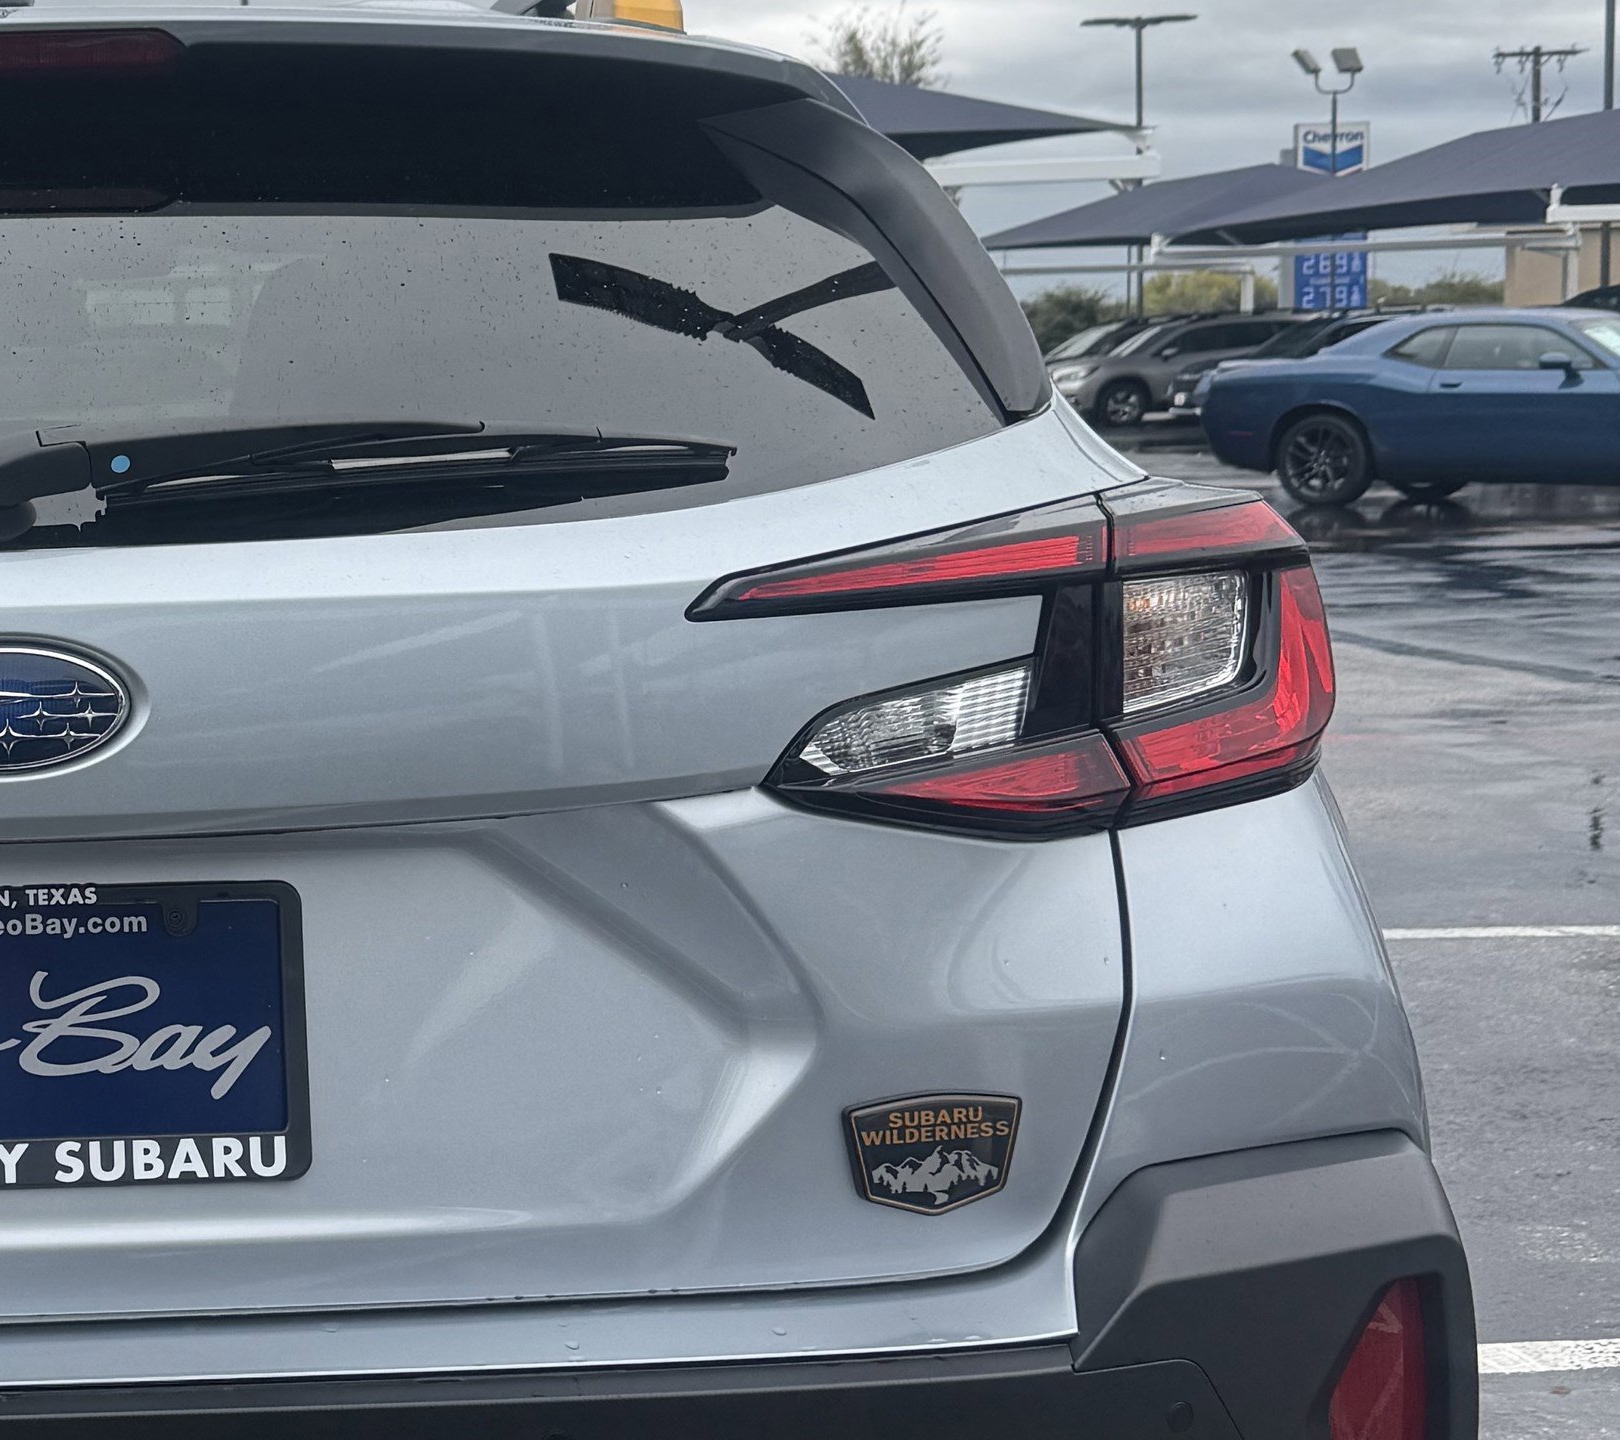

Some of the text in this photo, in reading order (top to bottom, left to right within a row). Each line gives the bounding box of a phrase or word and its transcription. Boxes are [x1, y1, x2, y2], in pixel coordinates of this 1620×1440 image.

[1303, 130, 1364, 144] Cheron
[25, 886, 98, 906] TEXAS
[18, 971, 272, 1100] Bay
[888, 1106, 983, 1128] SUBARU
[861, 1121, 1010, 1146] WILDERNESS
[54, 1135, 288, 1182] SUBARU
